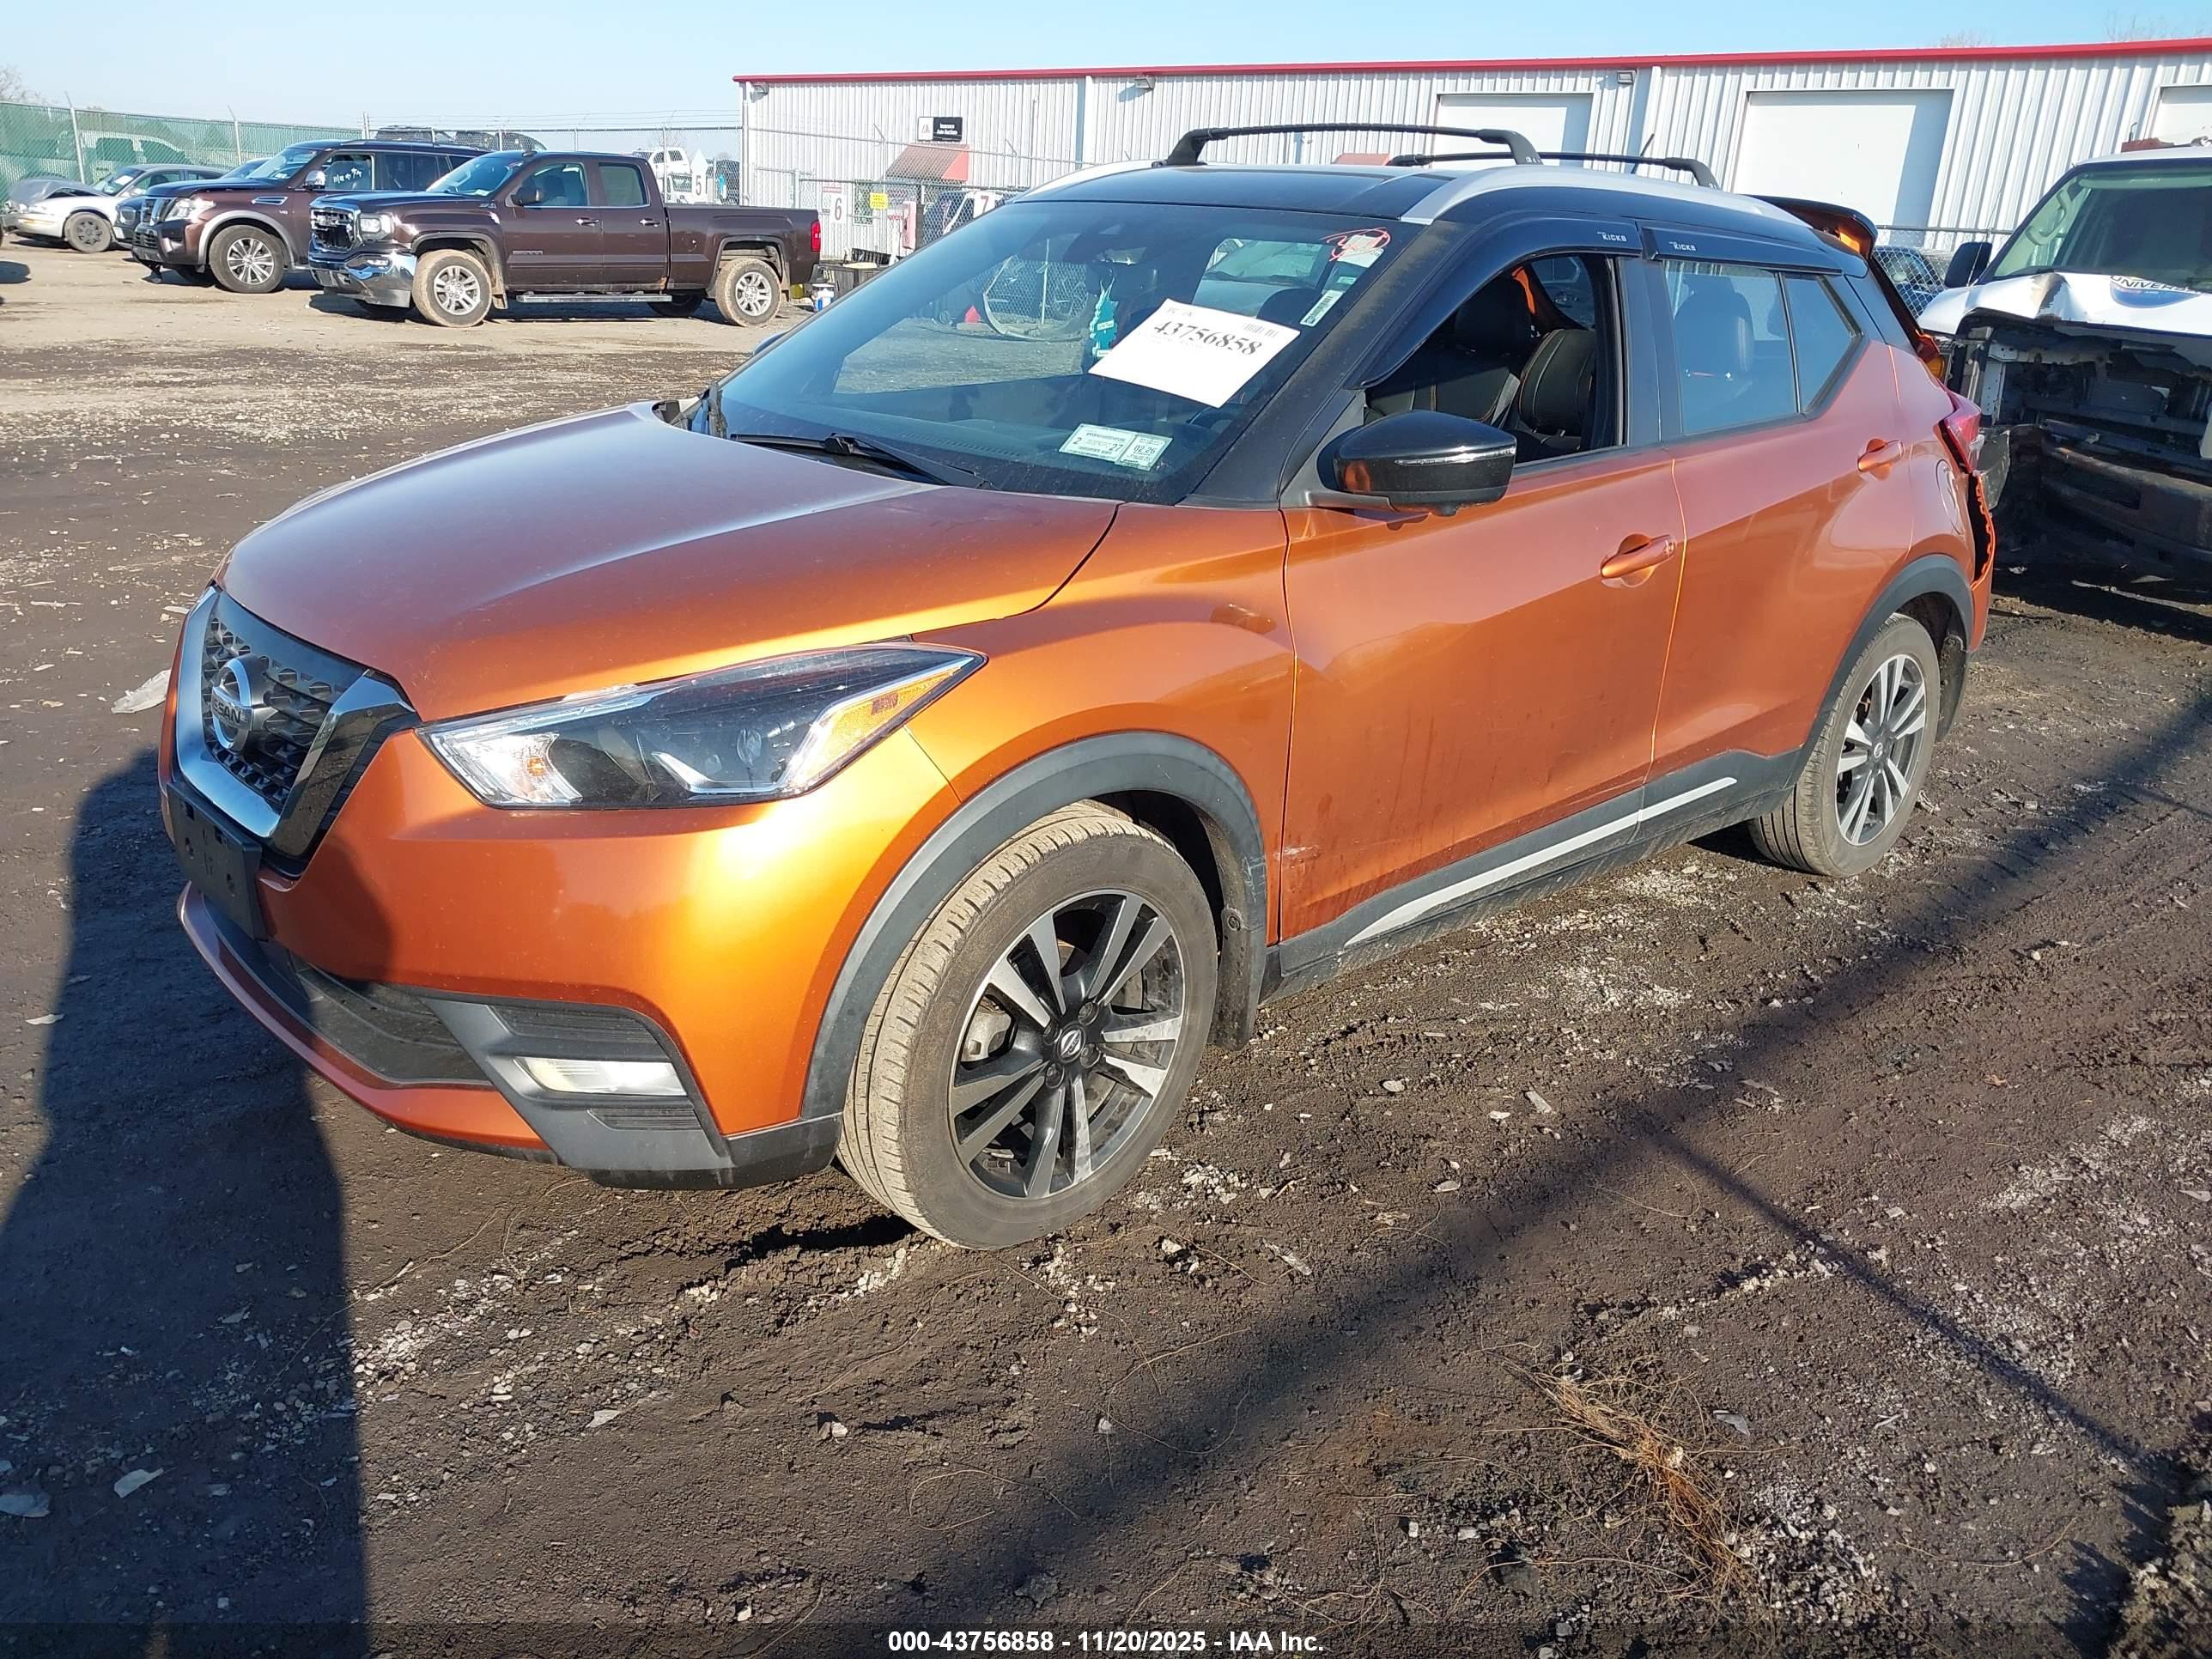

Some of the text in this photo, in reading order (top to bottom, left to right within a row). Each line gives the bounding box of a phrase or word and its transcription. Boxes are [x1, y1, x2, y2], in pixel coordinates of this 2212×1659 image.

[696, 174, 702, 196] 5
[835, 198, 842, 221] 6
[980, 195, 989, 214] 7
[1154, 321, 1262, 356] 43756858
